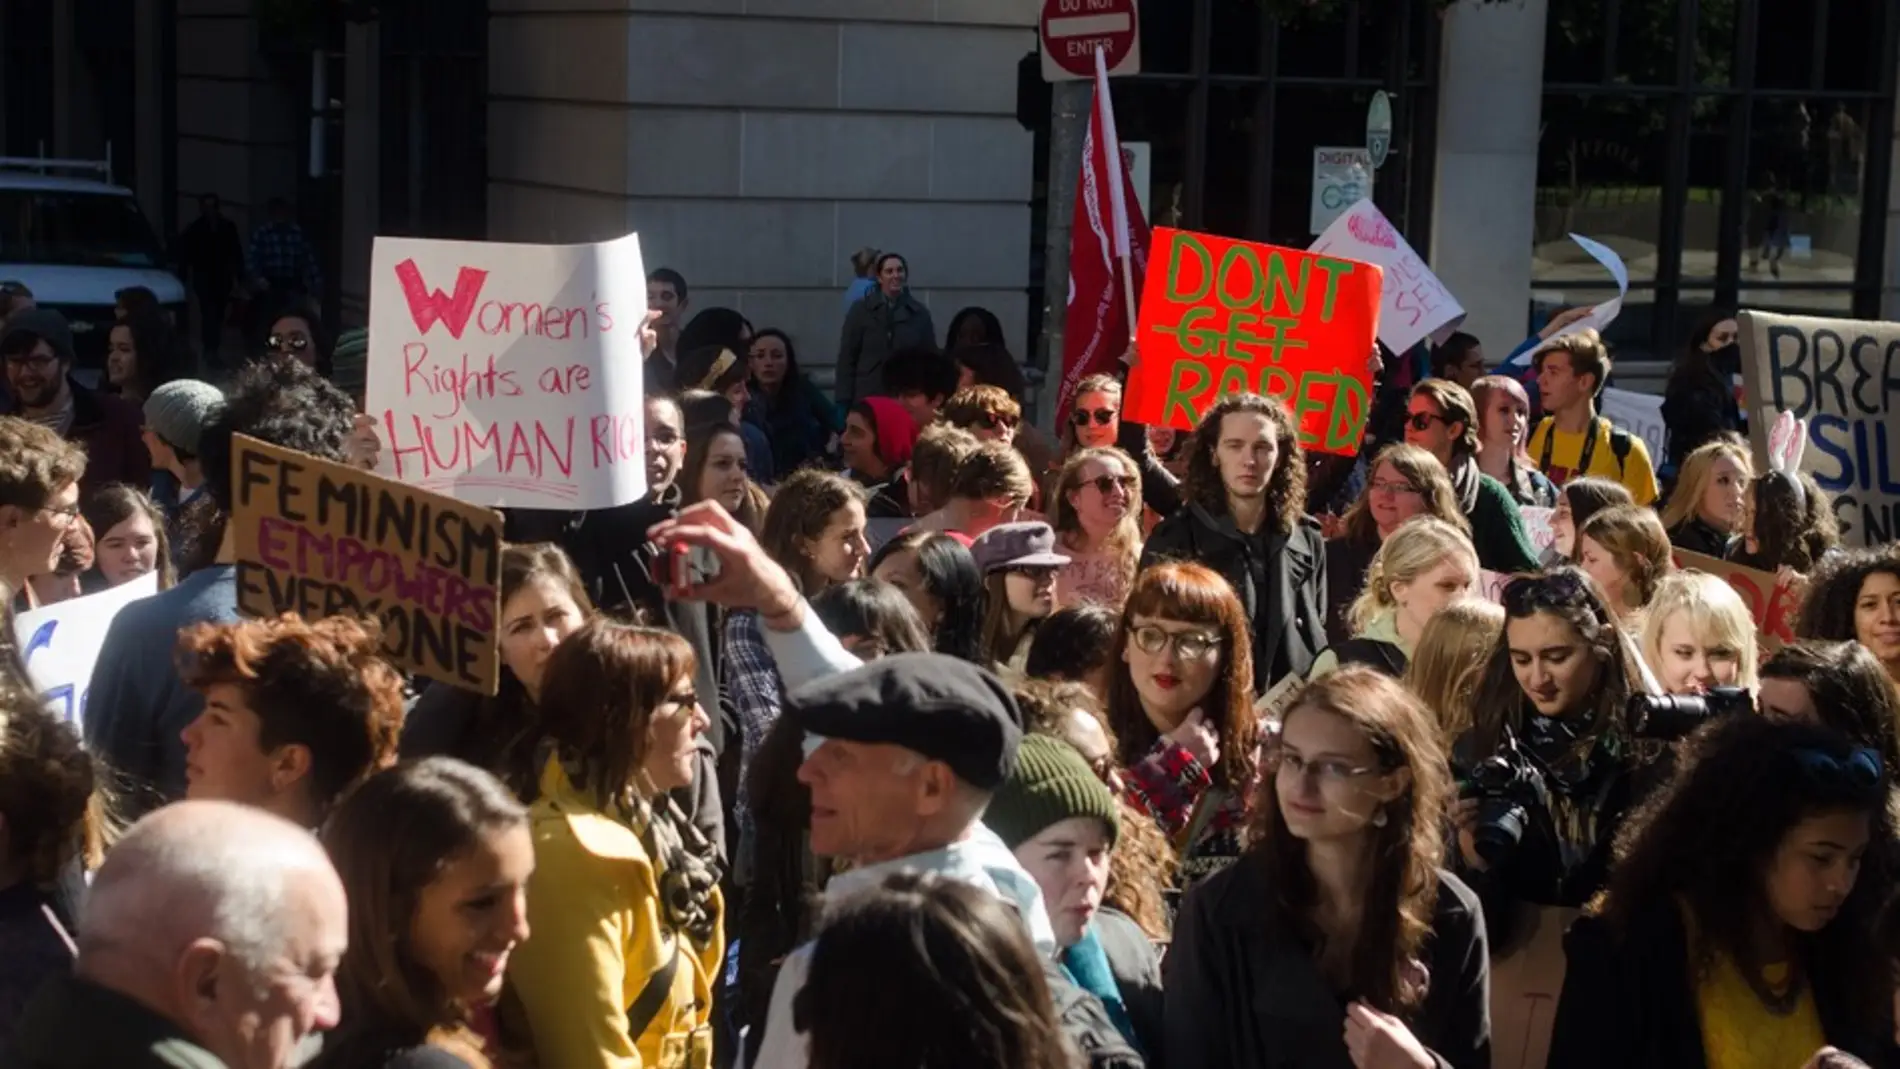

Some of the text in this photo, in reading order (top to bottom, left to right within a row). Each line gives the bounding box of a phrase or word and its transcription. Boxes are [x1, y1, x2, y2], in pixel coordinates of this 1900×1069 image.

[394, 258, 614, 340] Women's
[1165, 232, 1353, 322] DONT
[1176, 306, 1300, 363] GET
[403, 342, 592, 420] Rights are
[1162, 360, 1369, 451] RAPED
[384, 408, 576, 480] HUMAN
[240, 448, 498, 586] FEMINISM
[258, 515, 495, 633] EMPOWERS
